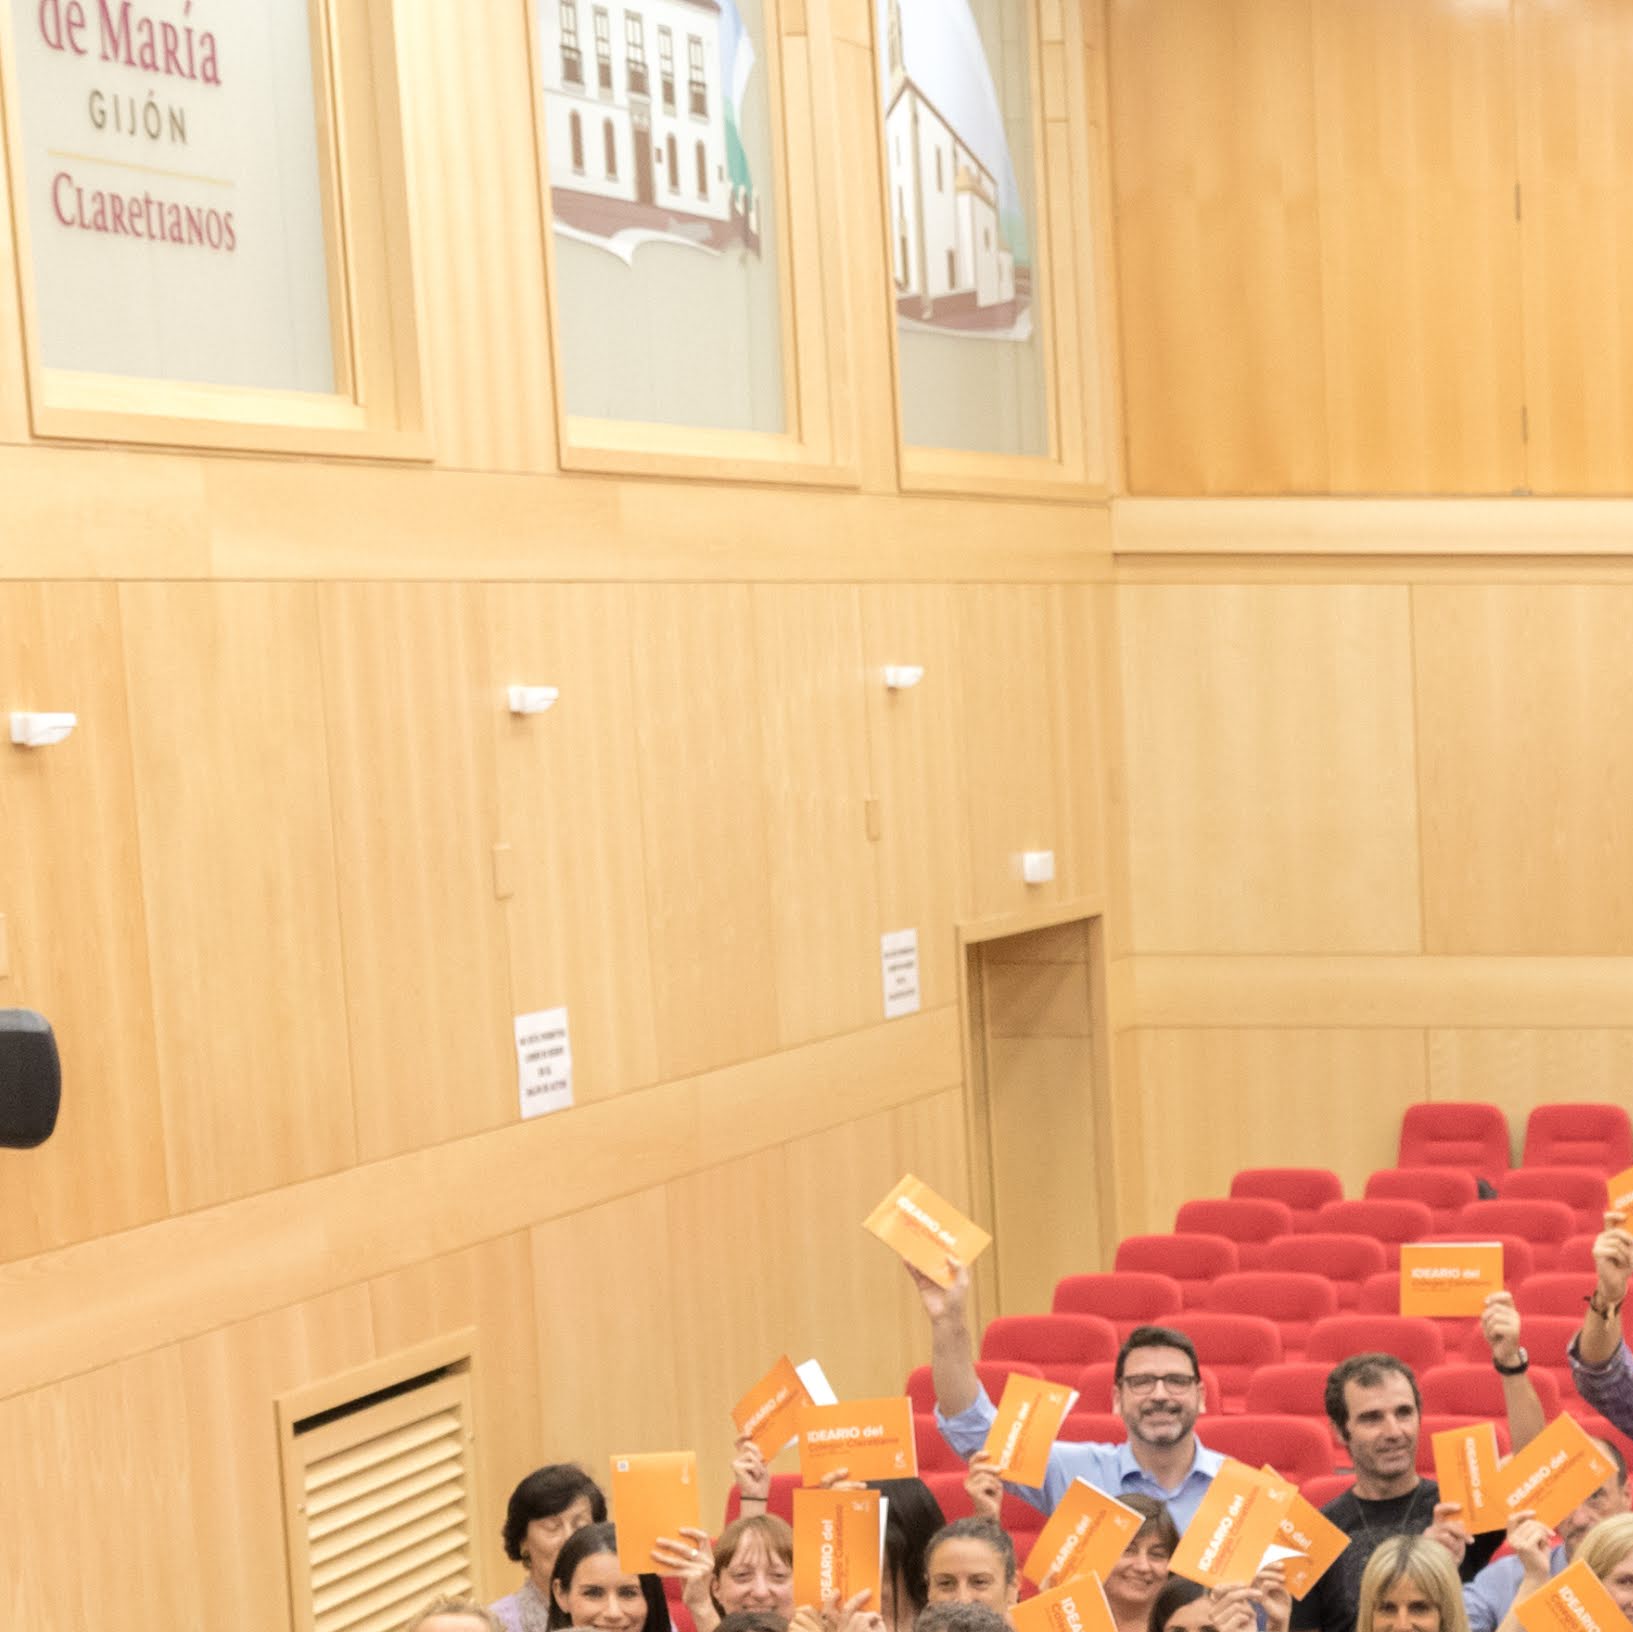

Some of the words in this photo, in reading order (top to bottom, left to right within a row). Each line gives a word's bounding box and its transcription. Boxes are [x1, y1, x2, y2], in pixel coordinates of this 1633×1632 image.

[37, 0, 88, 57] de
[87, 88, 188, 145] GIJÓN
[806, 1427, 860, 1442] IDEARIO
[862, 1424, 883, 1437] del
[1197, 1516, 1232, 1571] IDEARIO
[1228, 1493, 1245, 1516] del
